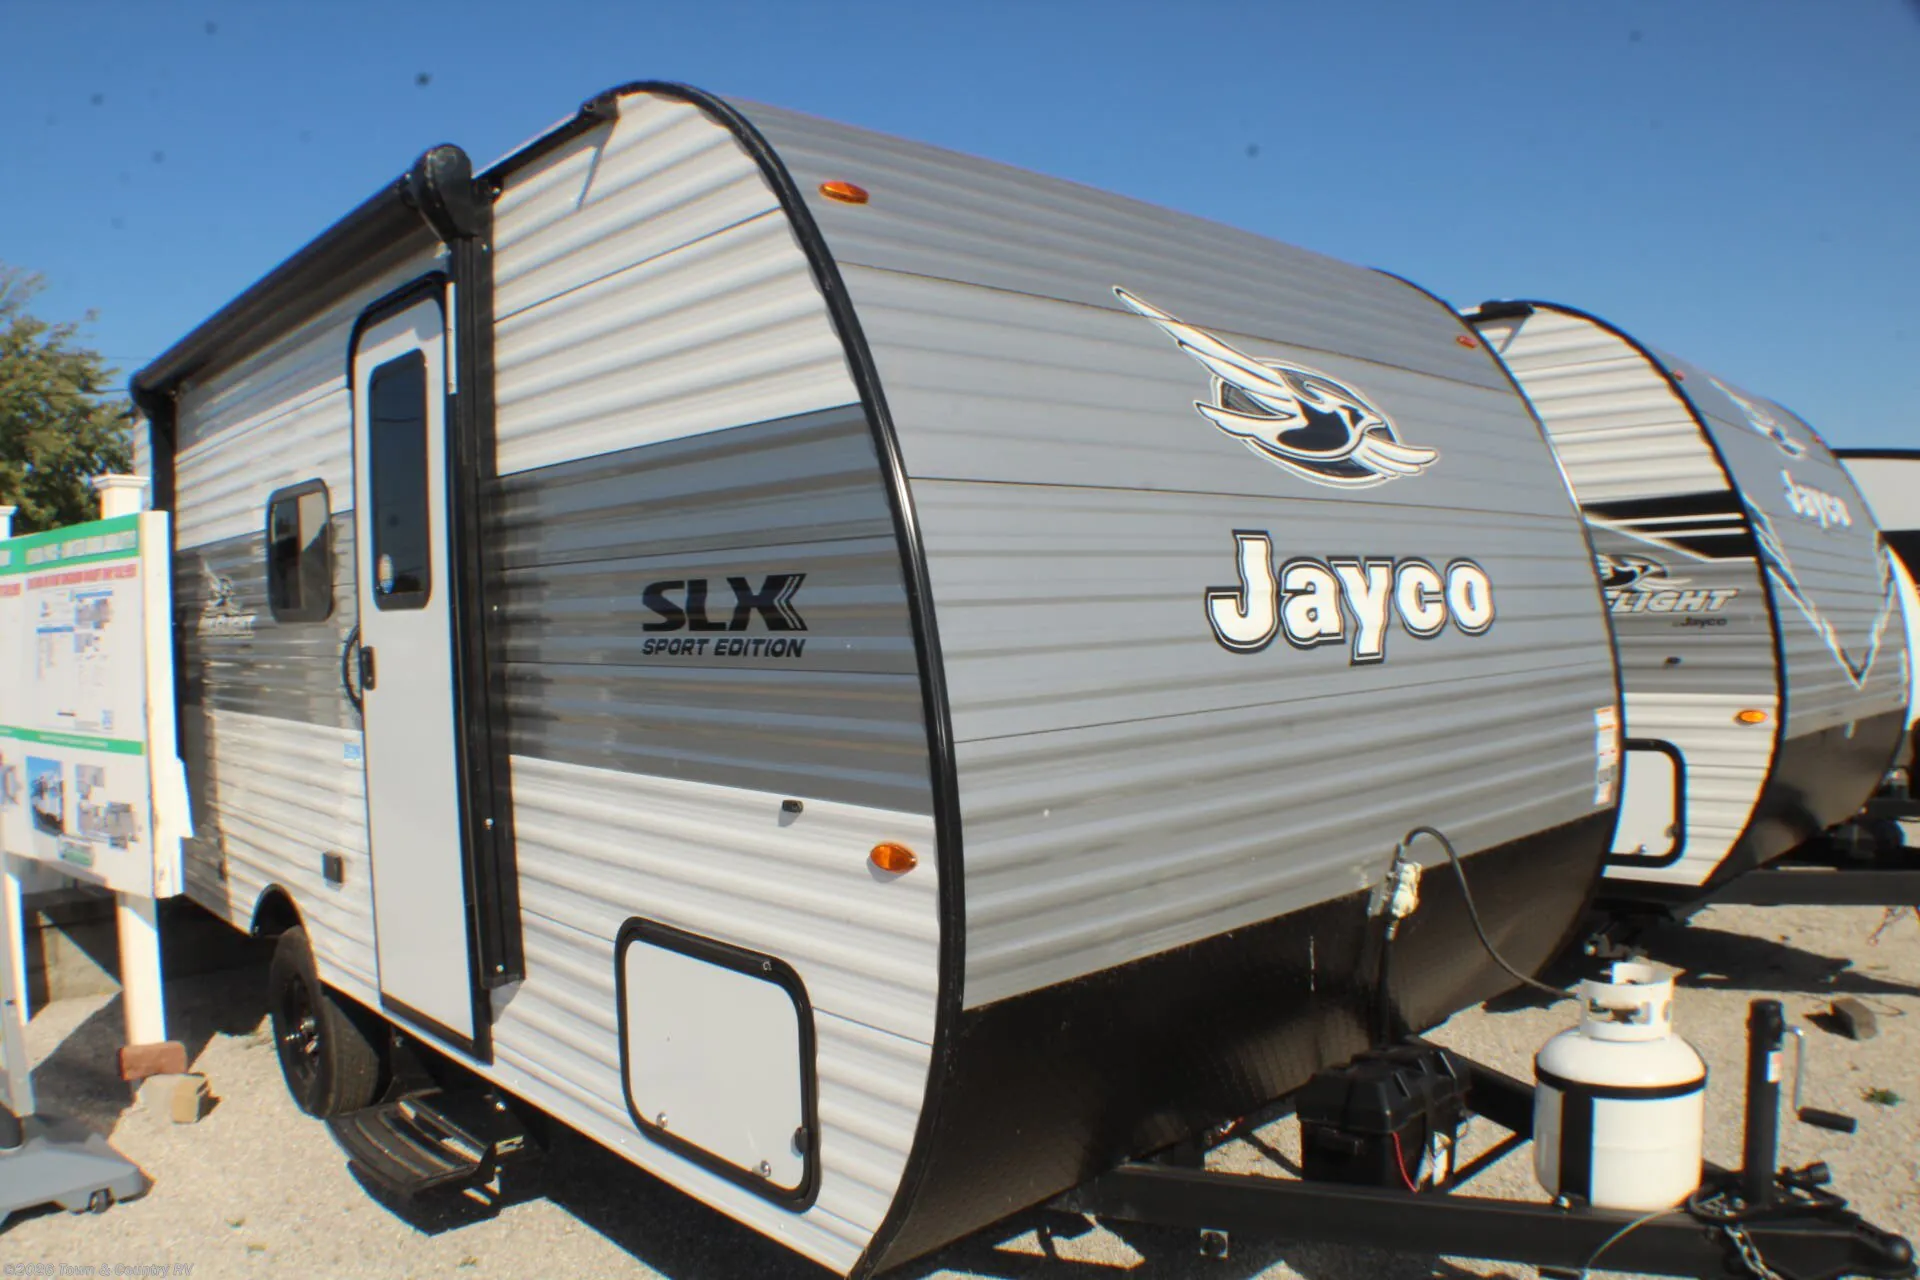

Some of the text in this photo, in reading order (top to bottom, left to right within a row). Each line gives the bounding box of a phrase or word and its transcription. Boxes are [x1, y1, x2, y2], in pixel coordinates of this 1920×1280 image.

[1780, 468, 1853, 530] Jayco
[642, 573, 808, 631] SLX
[1206, 529, 1495, 666] Jayco
[642, 638, 806, 658] SPORT EDITION
